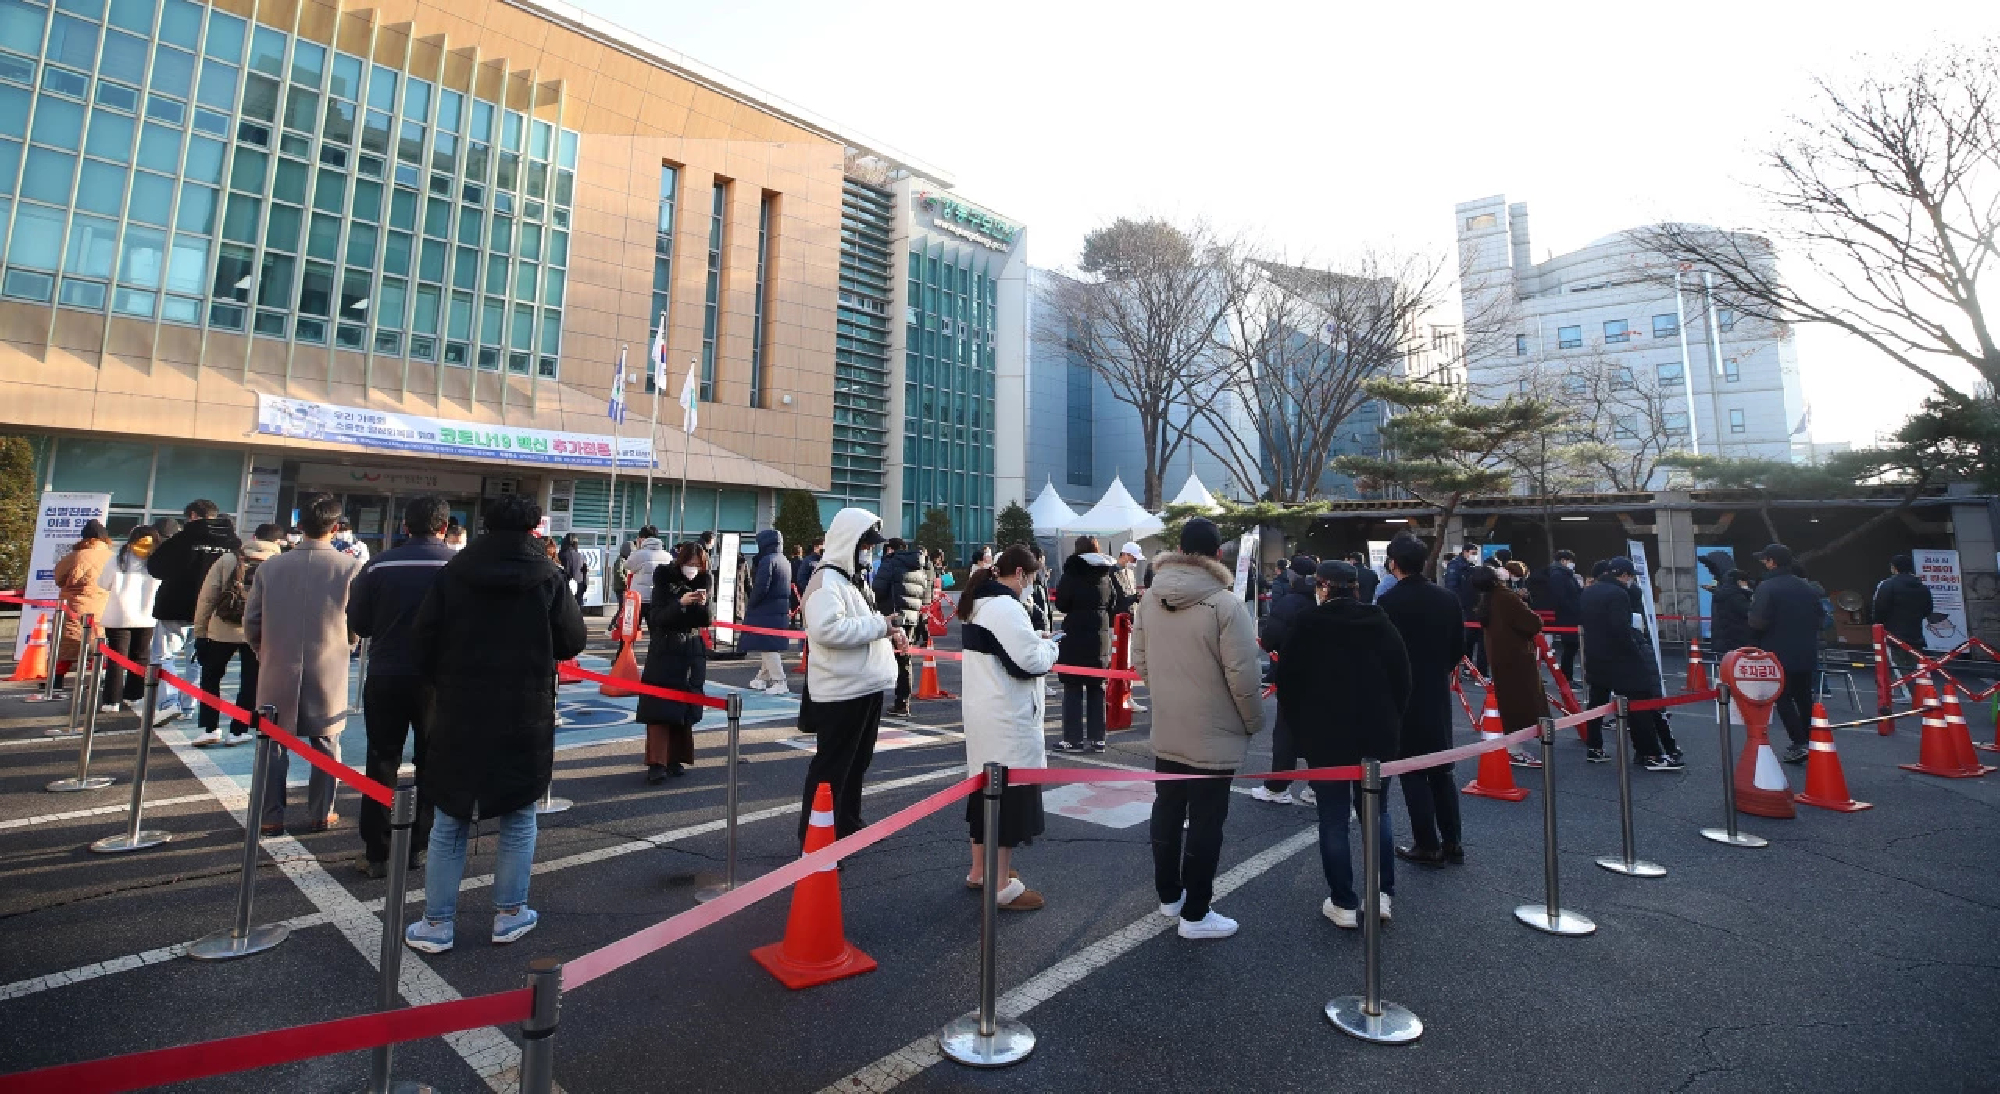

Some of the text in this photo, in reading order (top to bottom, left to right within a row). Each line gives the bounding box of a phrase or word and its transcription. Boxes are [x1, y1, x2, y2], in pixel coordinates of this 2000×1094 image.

[439, 427, 512, 449] 코로나19
[516, 434, 548, 453] 백신
[553, 438, 611, 456] 추가접종
[45, 506, 103, 516] 선별진료소
[48, 519, 70, 527] 이용
[1739, 666, 1777, 677] 주차금지
